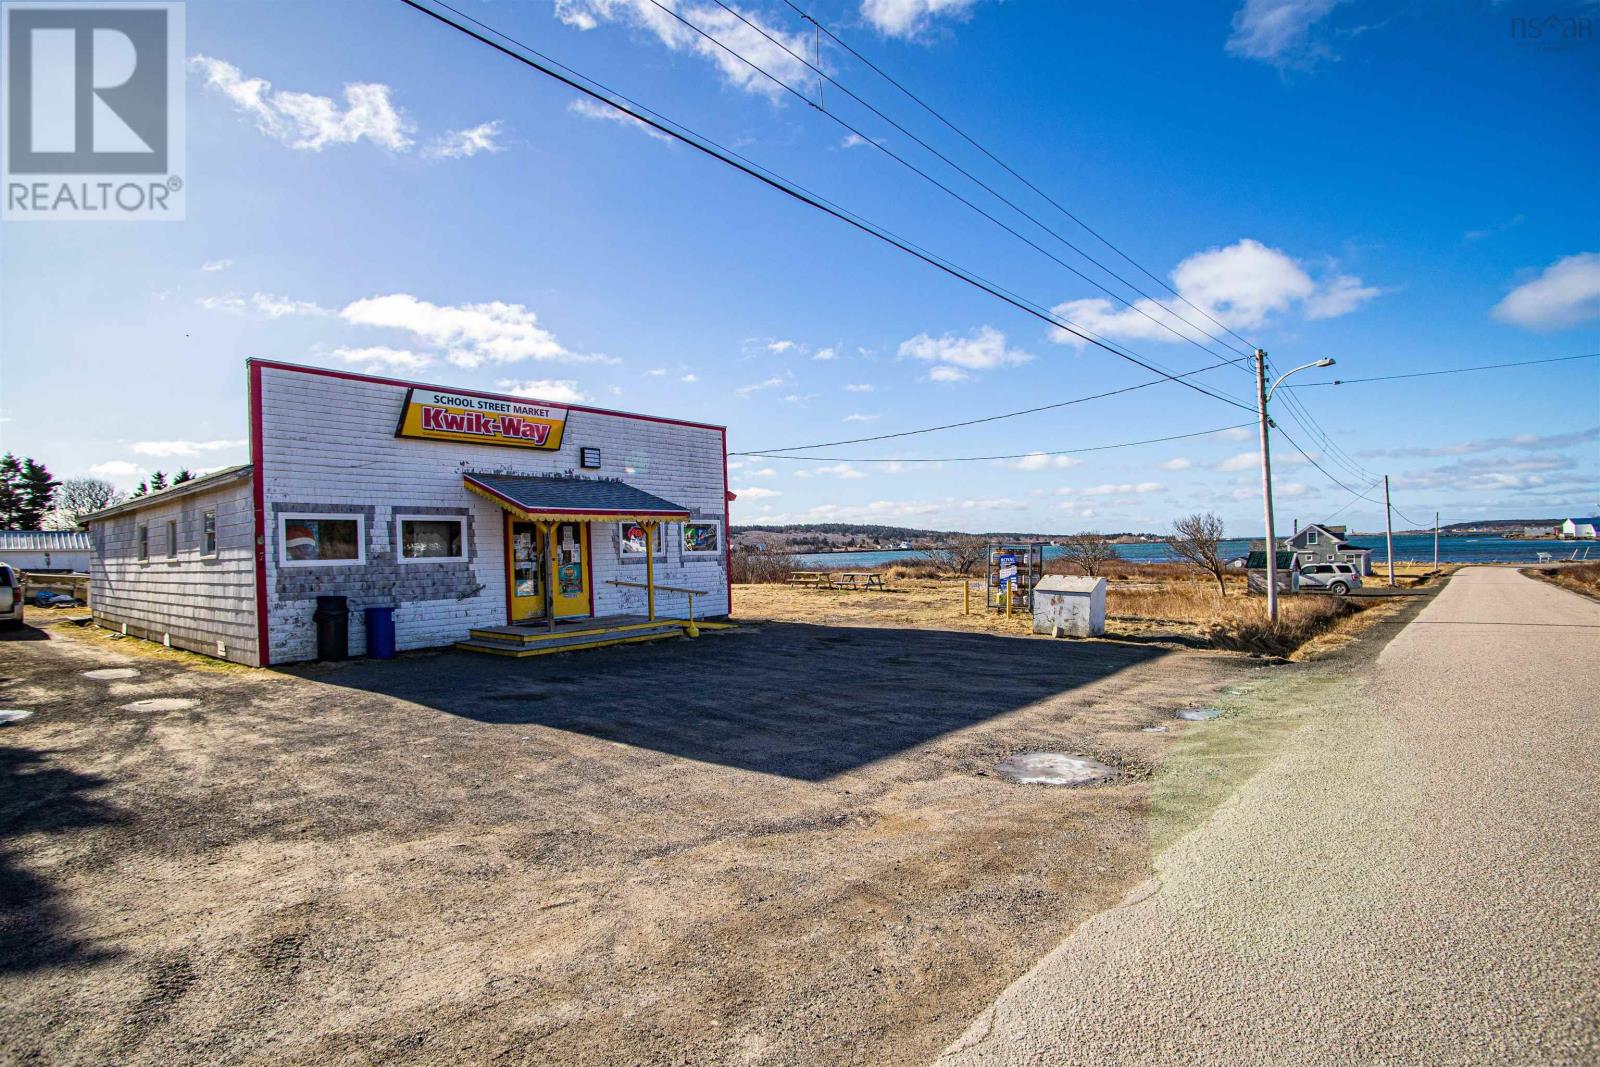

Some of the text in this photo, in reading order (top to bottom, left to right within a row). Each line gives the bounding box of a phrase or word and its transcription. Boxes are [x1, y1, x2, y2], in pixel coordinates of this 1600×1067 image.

[433, 394, 550, 417] SCHOOL STREET MARKET
[422, 406, 551, 445] Kwik-Way
